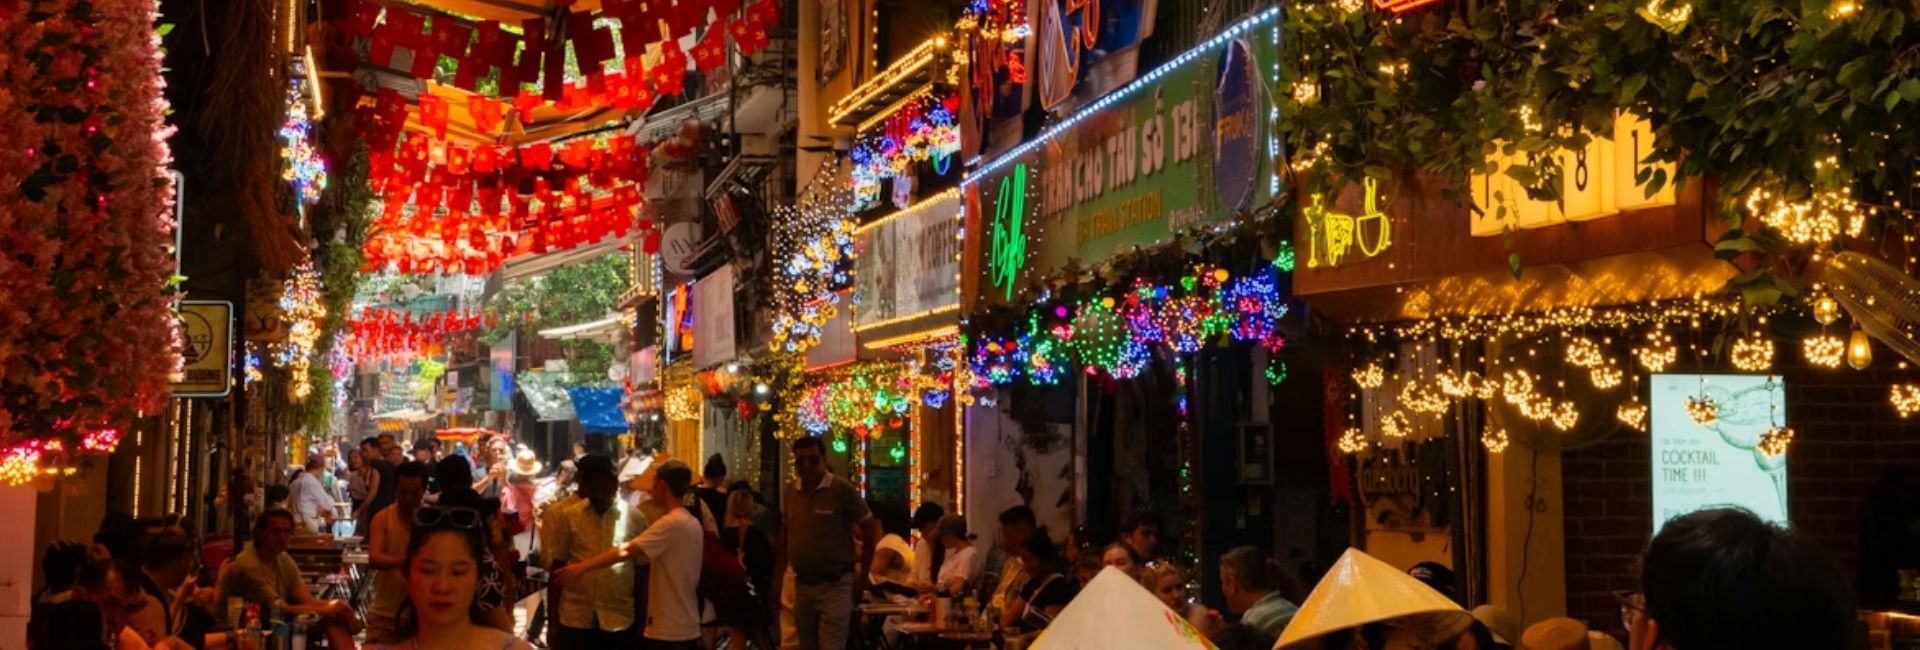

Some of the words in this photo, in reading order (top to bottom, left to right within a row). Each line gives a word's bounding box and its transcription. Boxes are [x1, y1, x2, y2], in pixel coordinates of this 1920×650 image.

[1120, 190, 1161, 230] STATION
[1662, 448, 1720, 465] COCKTAIL
[1661, 467, 1689, 482] TIME
[1693, 467, 1706, 482] !!!
